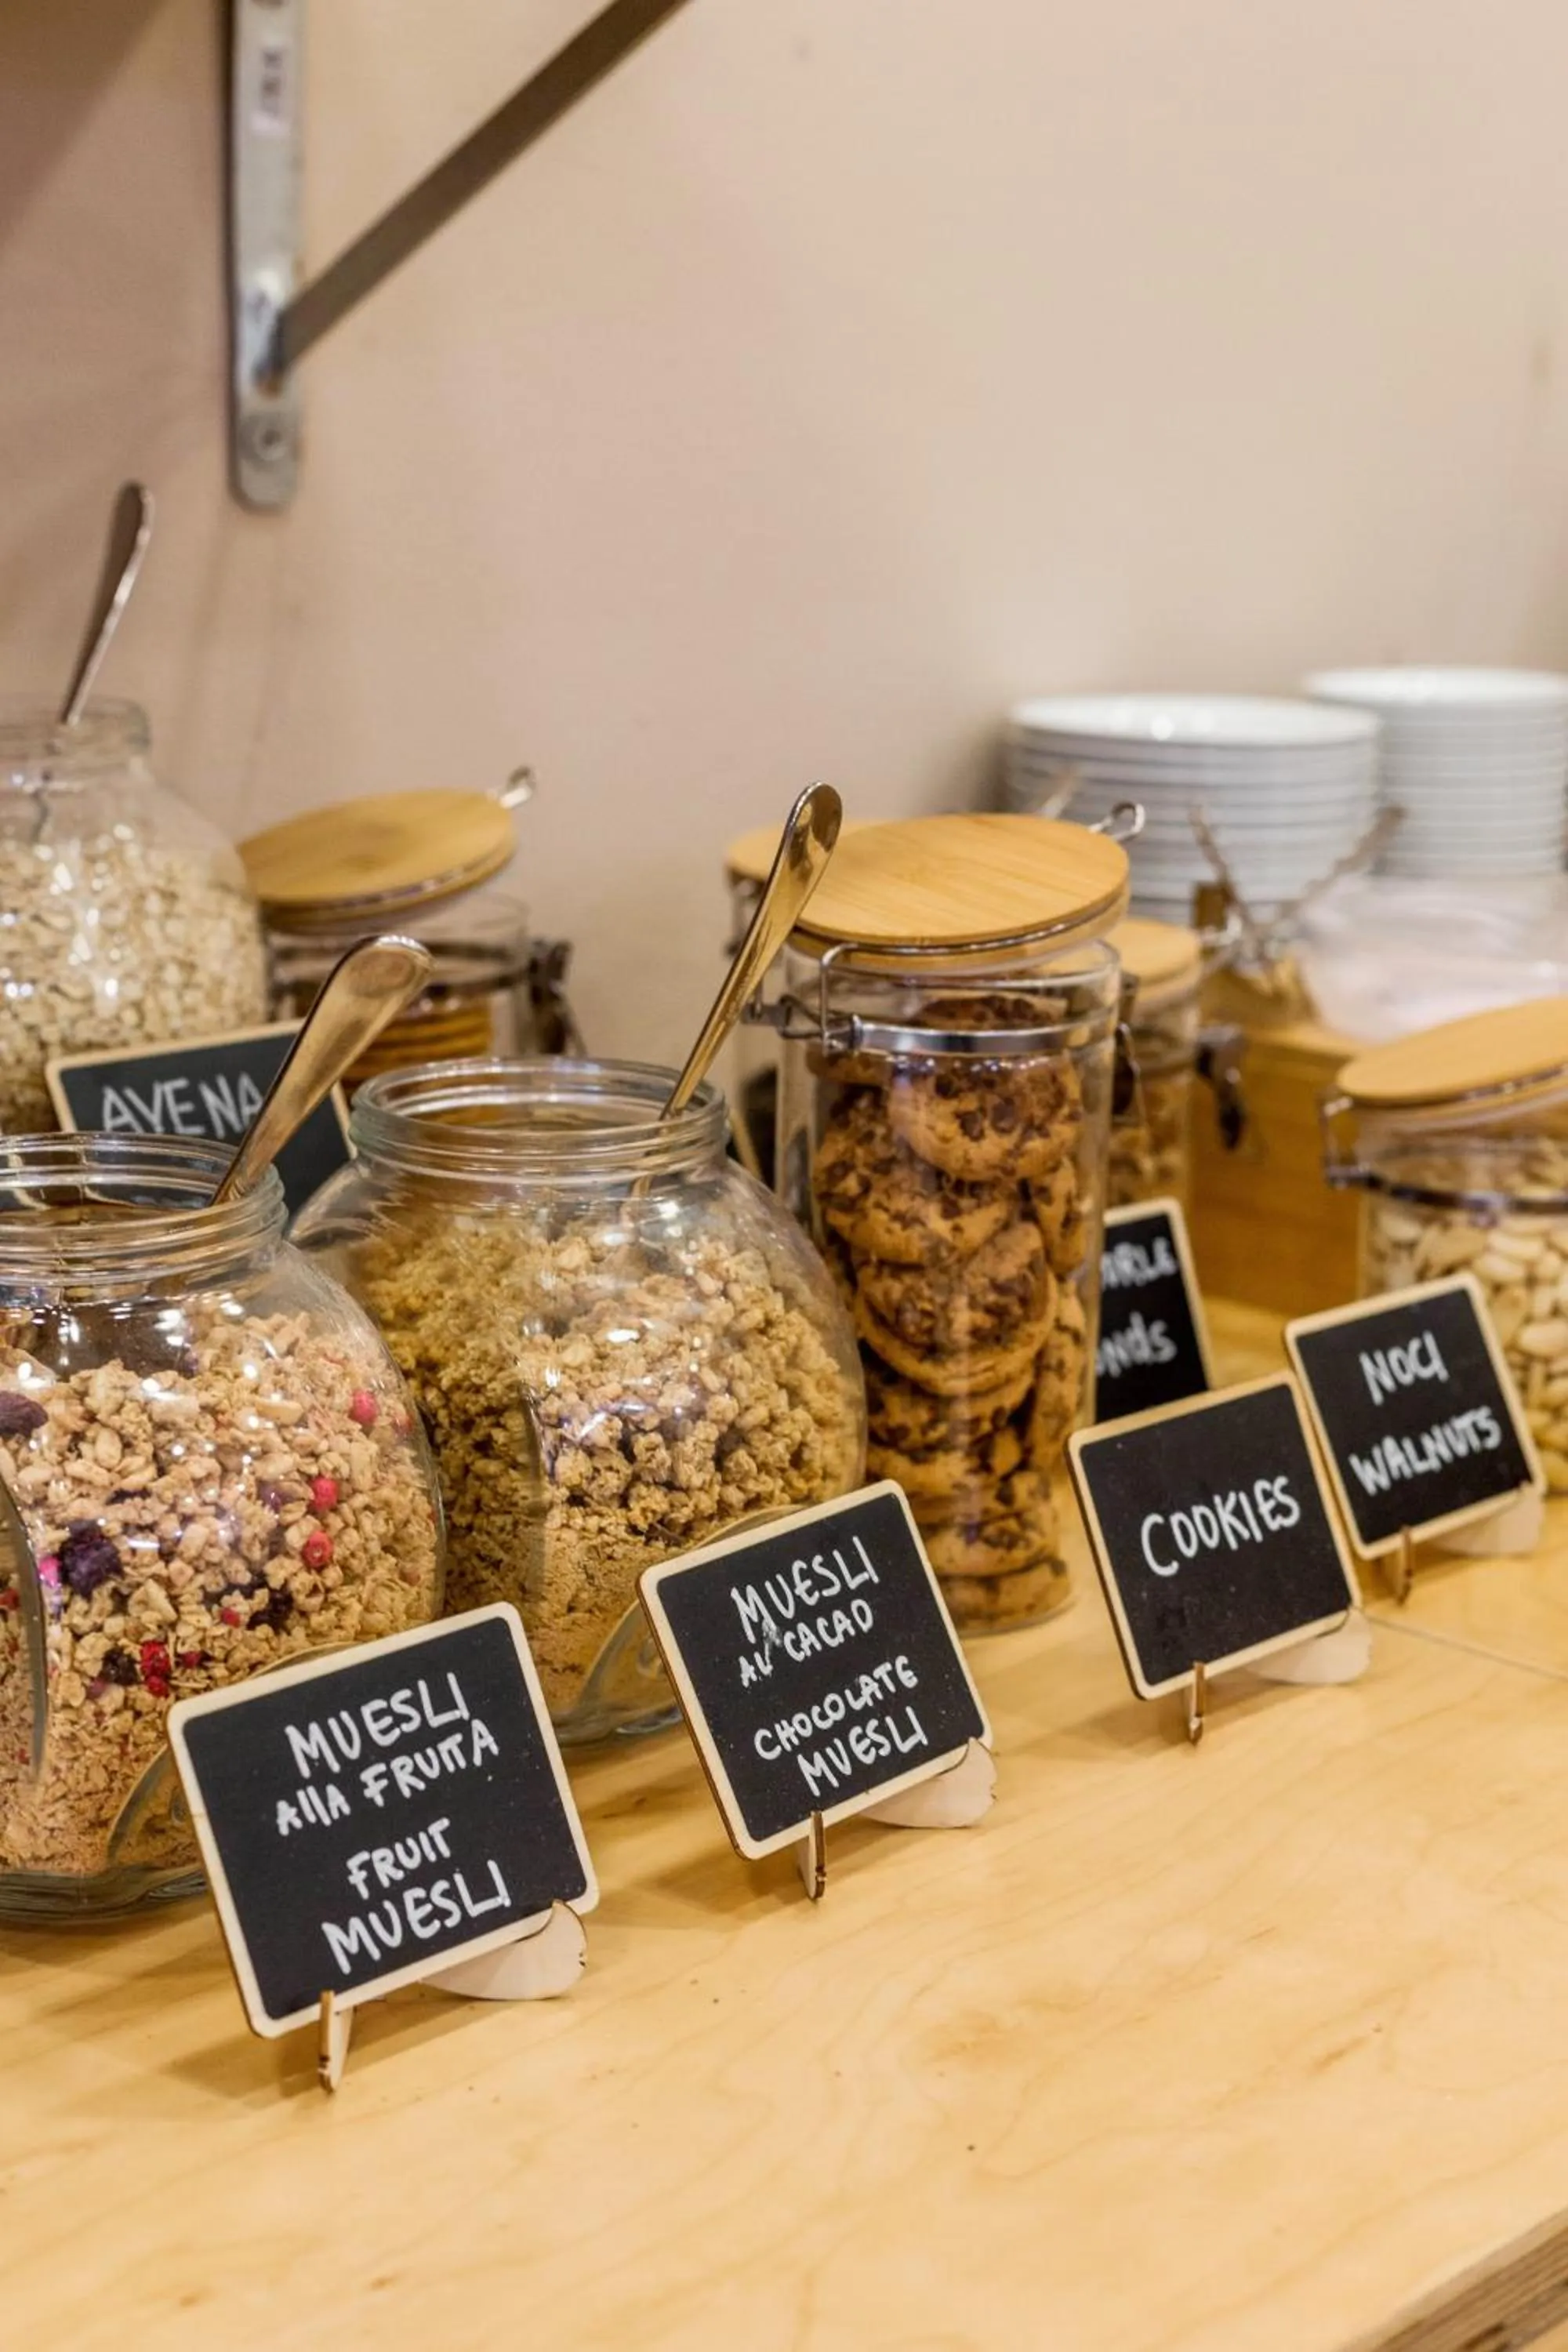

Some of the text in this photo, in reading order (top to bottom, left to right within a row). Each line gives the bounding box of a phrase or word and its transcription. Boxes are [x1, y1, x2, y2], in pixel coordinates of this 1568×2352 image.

[101, 1071, 265, 1140] AVENA
[1359, 1331, 1449, 1405] NOCI
[1349, 1406, 1501, 1494] WALNUTS
[1141, 1475, 1301, 1577] COOKIES
[730, 1536, 880, 1646] MUESLI
[783, 1599, 873, 1662] CACAO
[284, 1672, 470, 1779] MUESLI
[753, 1655, 919, 1760] CHOCOLATE
[797, 1706, 929, 1797] MUESLI
[359, 1719, 499, 1807] FRUTTA
[346, 1817, 451, 1900] FRUIT
[321, 1859, 512, 1975] MUESLI
